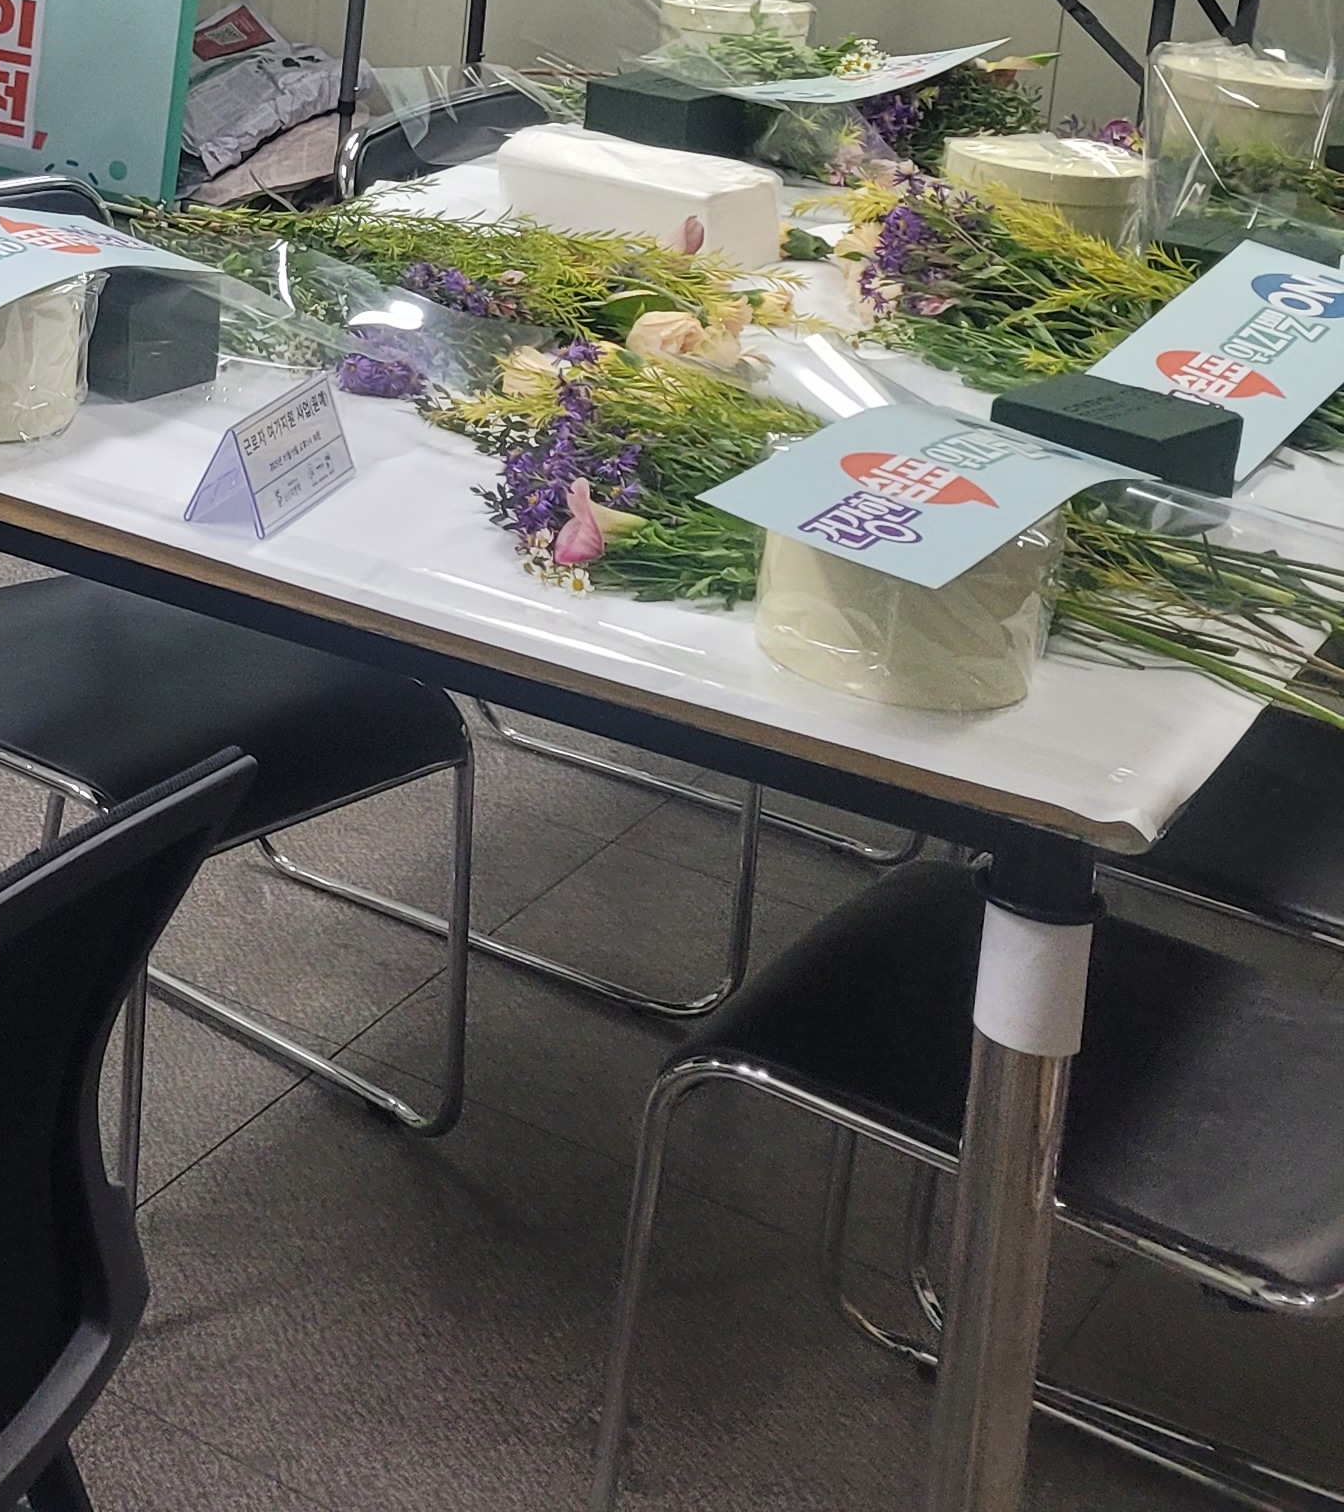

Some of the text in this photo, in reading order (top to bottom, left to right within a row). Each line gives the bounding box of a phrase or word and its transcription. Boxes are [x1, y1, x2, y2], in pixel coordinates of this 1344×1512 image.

[1172, 351, 1254, 398] 쉼표
[1220, 306, 1330, 364] 워라밸
[243, 428, 267, 457] 근로자
[266, 409, 298, 441] 여가지원
[856, 452, 959, 506] 쉼표
[799, 493, 924, 551] 건강한
